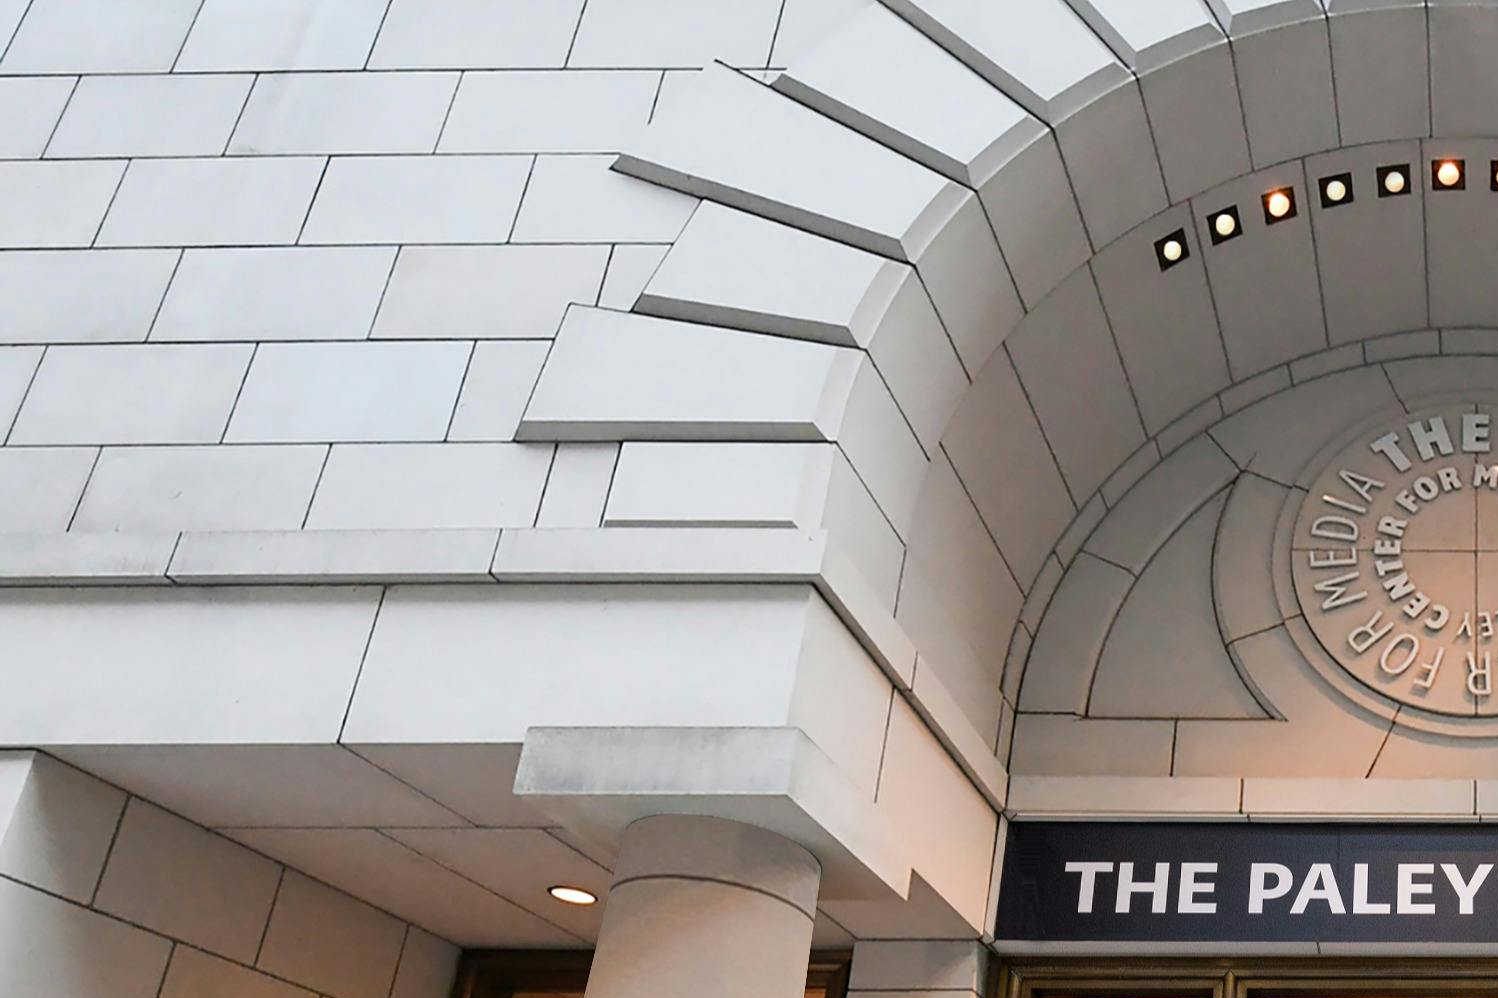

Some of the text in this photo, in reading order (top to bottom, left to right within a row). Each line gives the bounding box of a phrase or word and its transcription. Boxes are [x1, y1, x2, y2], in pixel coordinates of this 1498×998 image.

[1370, 414, 1492, 472] THE
[1395, 466, 1463, 514] FOR
[1309, 469, 1385, 611] MEDIA
[1373, 515, 1450, 631] CENTER
[1347, 610, 1445, 692] FOR
[1065, 863, 1217, 913] THE
[1249, 863, 1494, 914] PALEY
